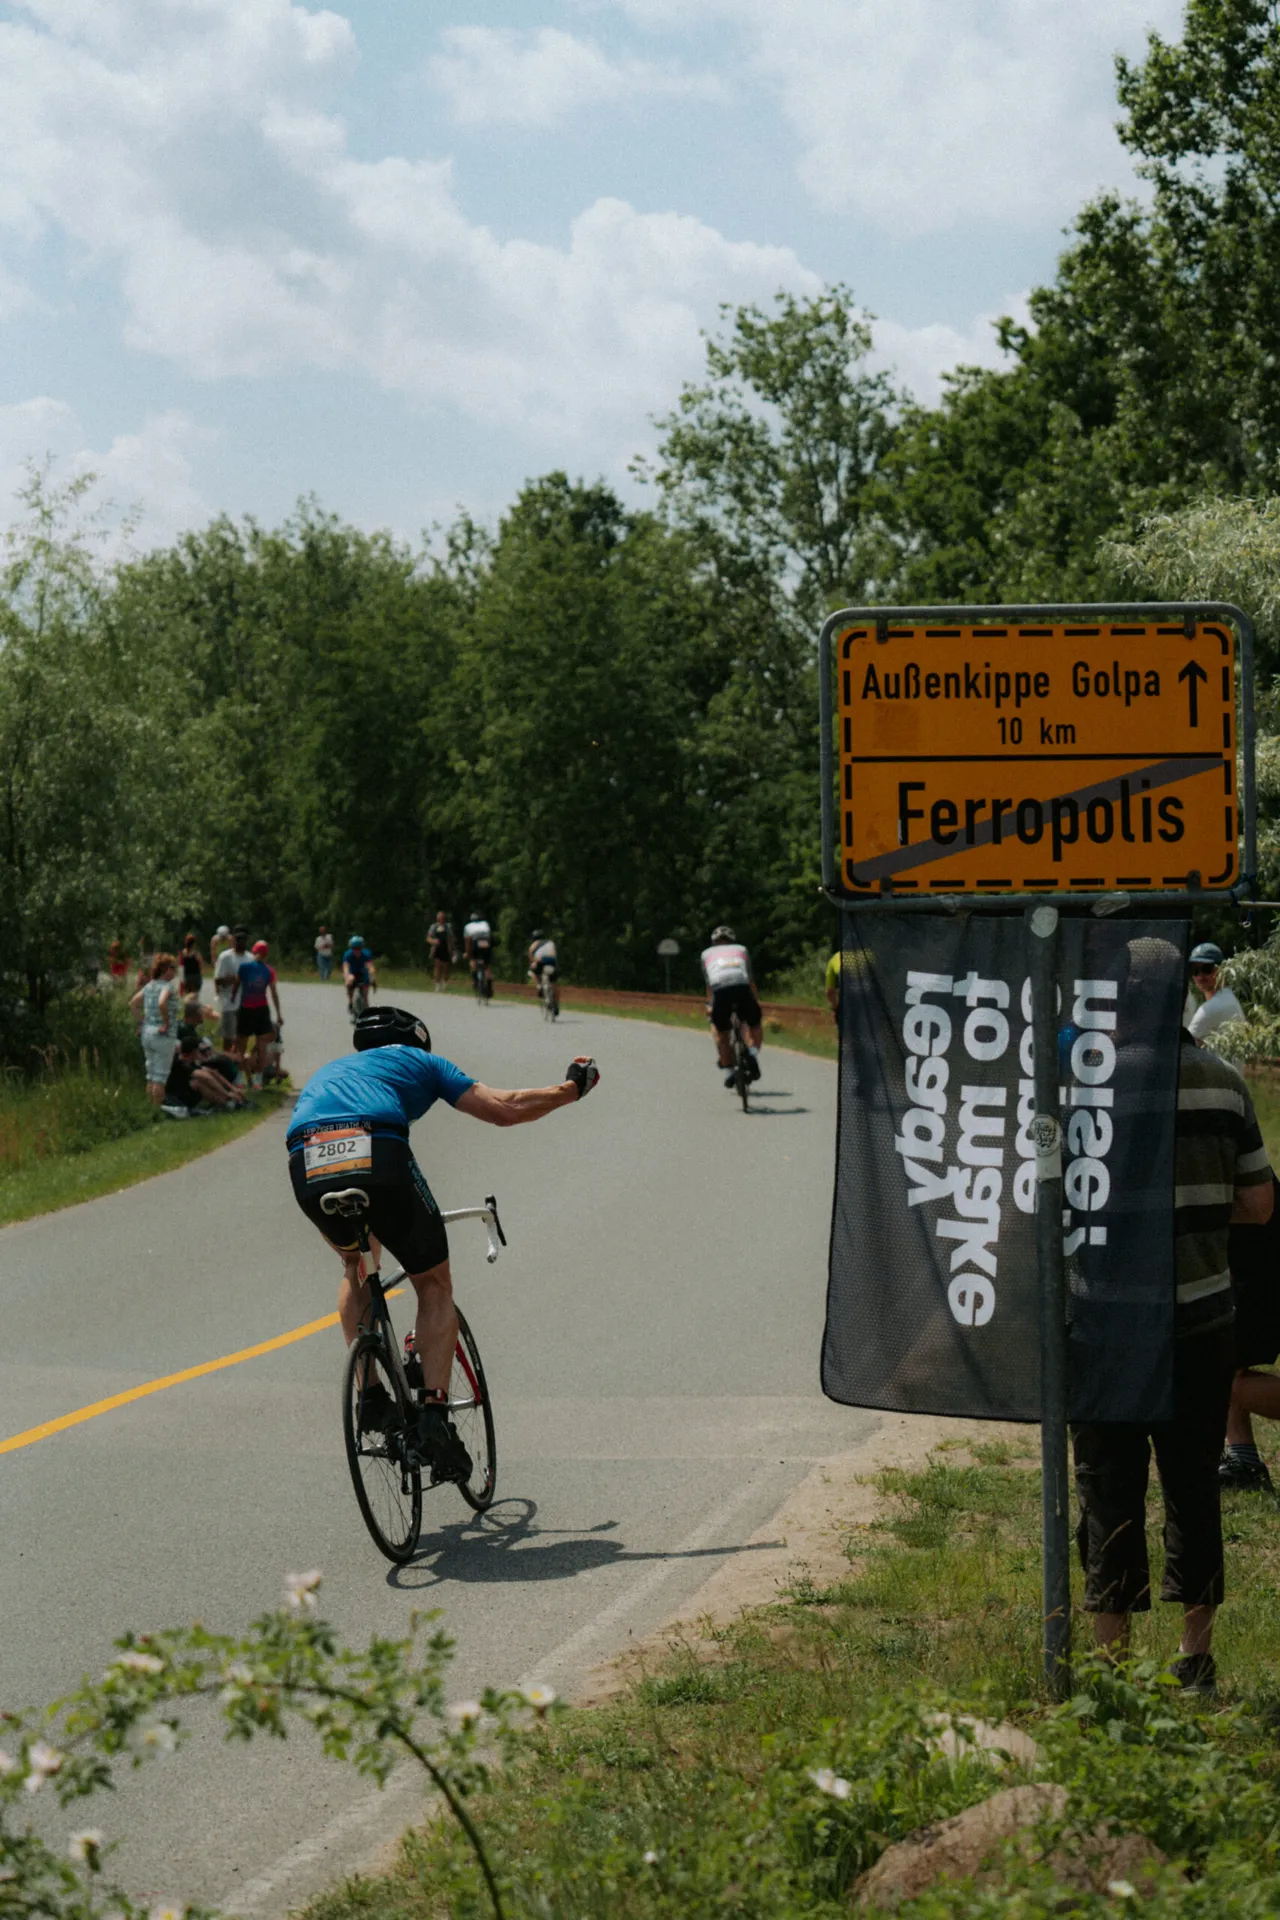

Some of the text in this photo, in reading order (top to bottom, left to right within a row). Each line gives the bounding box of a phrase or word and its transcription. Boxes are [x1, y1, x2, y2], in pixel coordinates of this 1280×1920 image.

[861, 660, 1161, 708] Außenkippe Golpa
[997, 717, 1076, 745] 10 km
[898, 779, 1185, 862] Ferropolis
[317, 1140, 356, 1158] 2802
